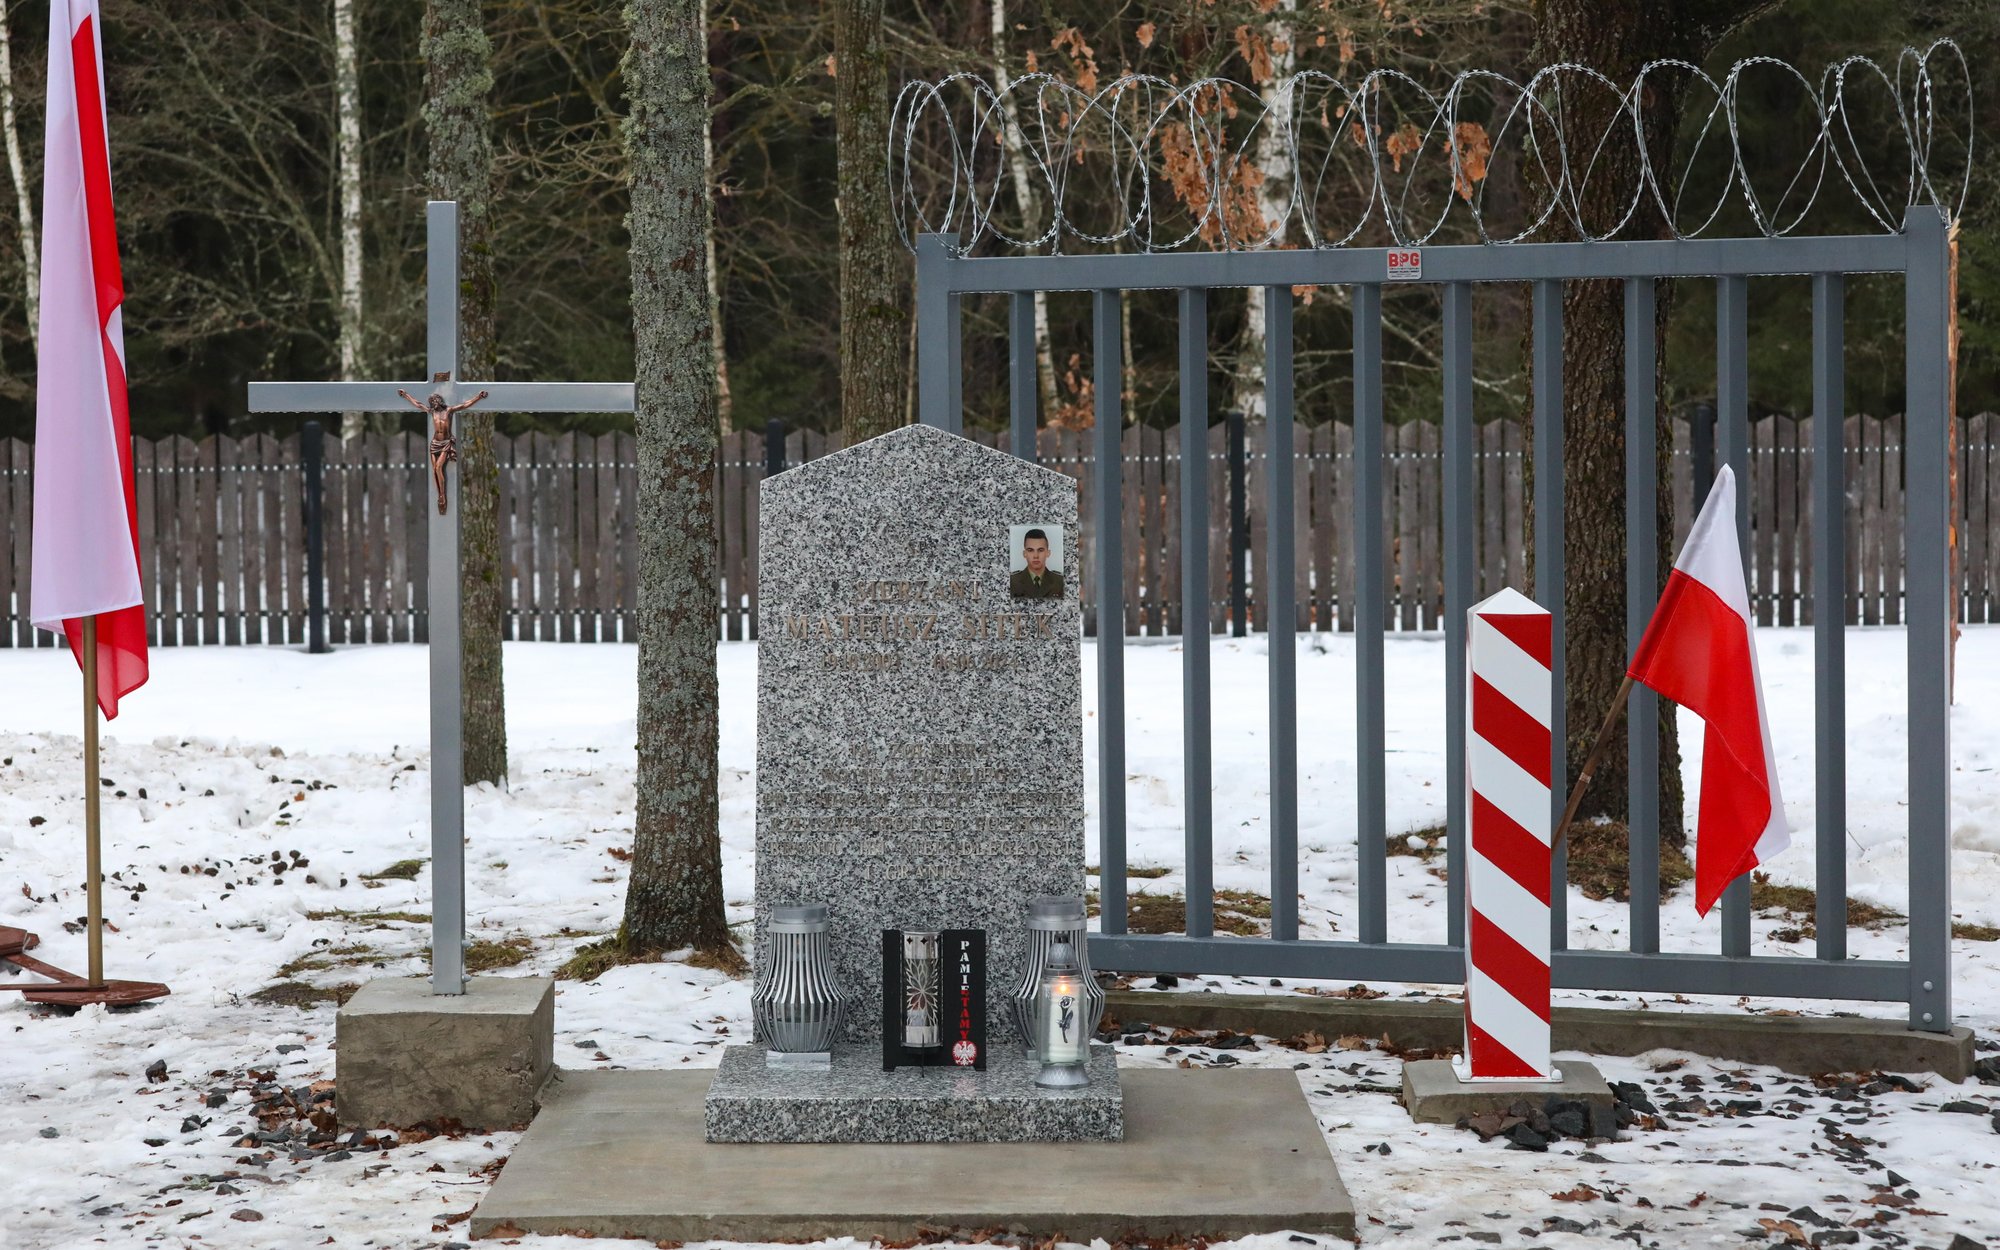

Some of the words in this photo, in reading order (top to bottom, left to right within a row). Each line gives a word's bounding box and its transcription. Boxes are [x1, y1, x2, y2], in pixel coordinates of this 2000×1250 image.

[1389, 252, 1420, 267] BPG
[785, 614, 937, 640] MATEUSZ
[962, 614, 1055, 640] SITEK
[885, 864, 963, 881] GRANIC
